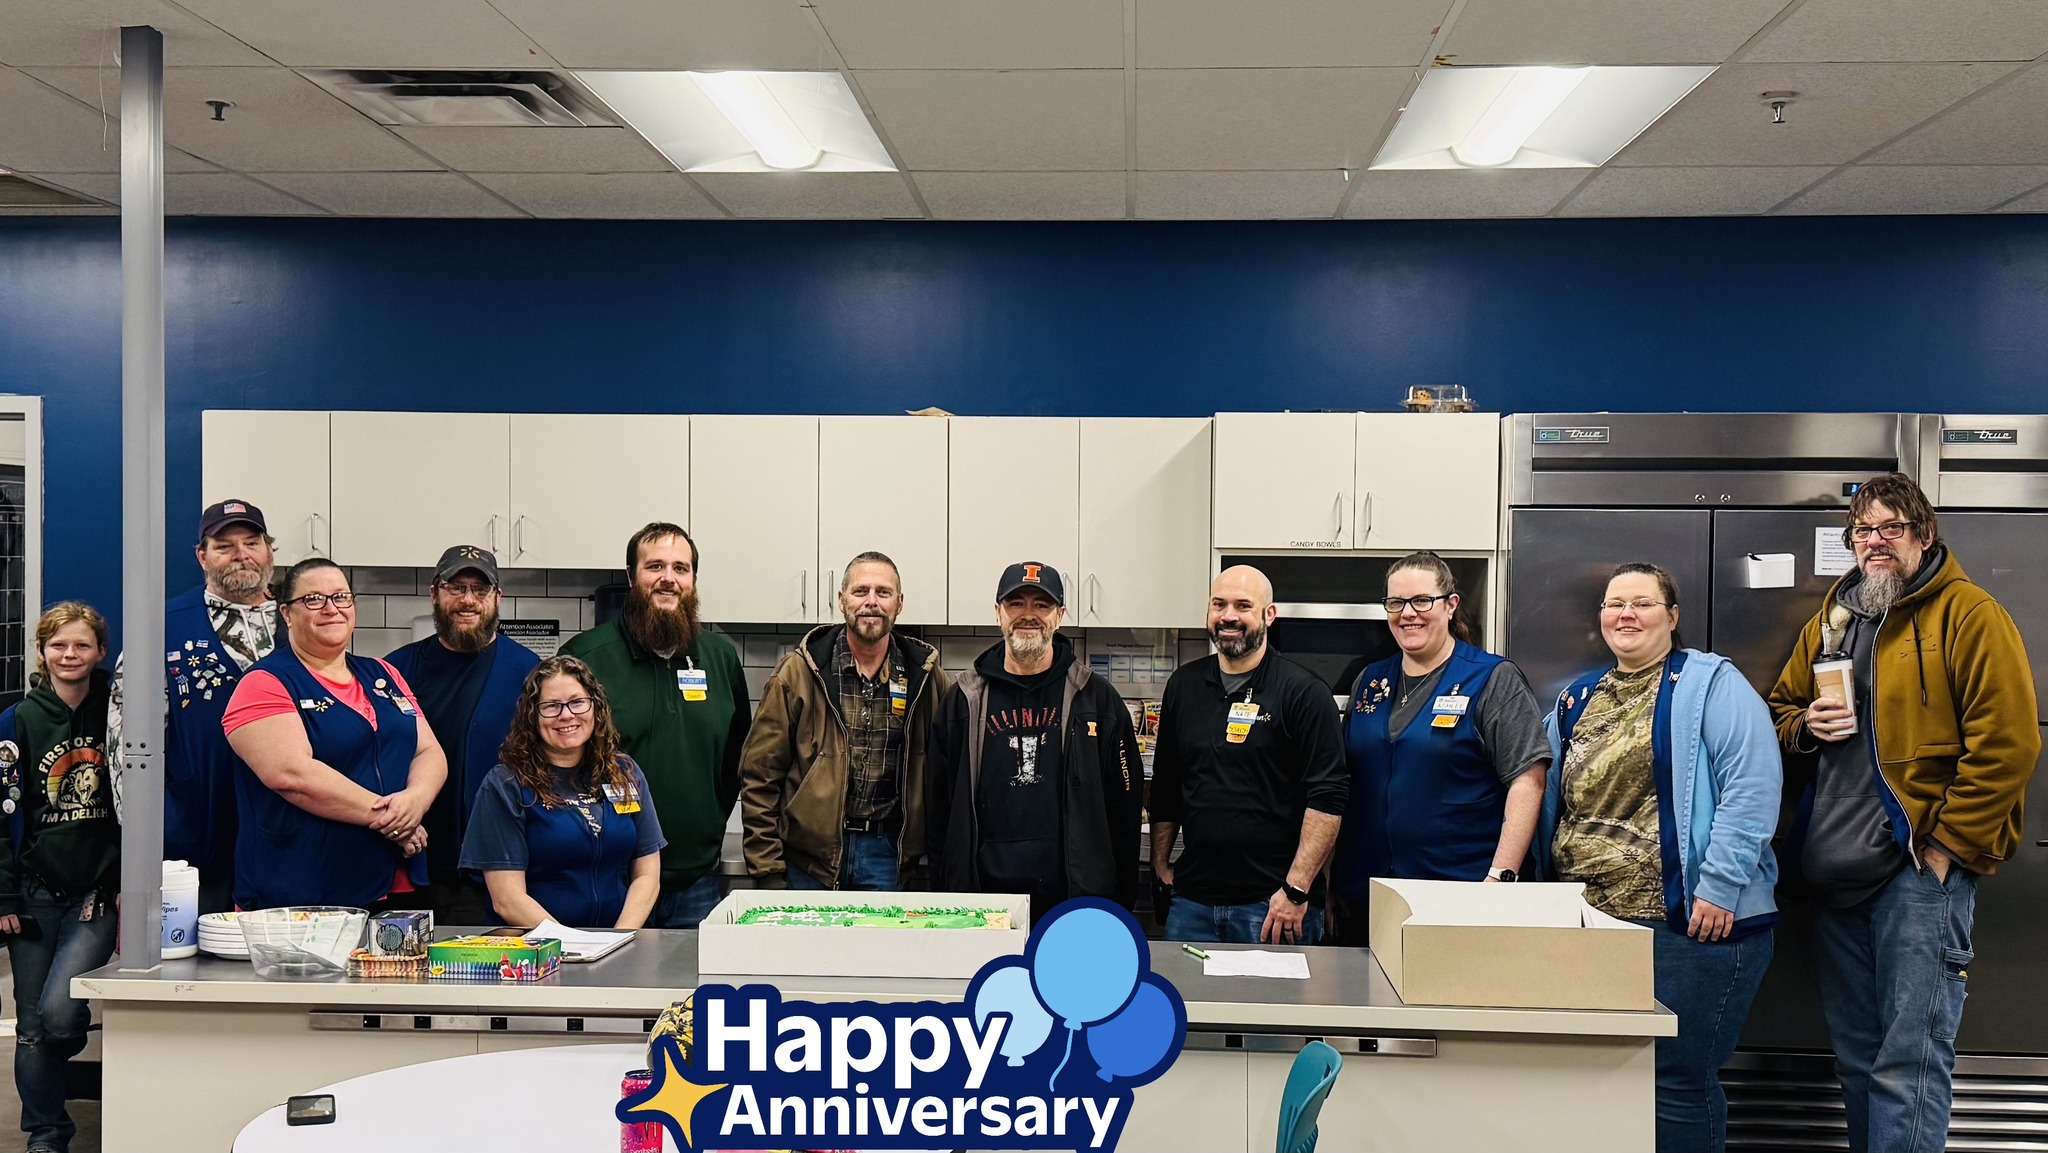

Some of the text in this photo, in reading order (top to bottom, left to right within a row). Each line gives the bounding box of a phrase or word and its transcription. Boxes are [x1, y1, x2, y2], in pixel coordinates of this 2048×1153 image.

[1564, 429, 1605, 438] True
[1973, 430, 2012, 439] True
[1023, 564, 1041, 583] I
[986, 707, 1061, 736] ILLINOI
[38, 740, 72, 774] FIRST
[73, 736, 94, 748] OF
[41, 813, 59, 823] I'M
[60, 812, 69, 822] A
